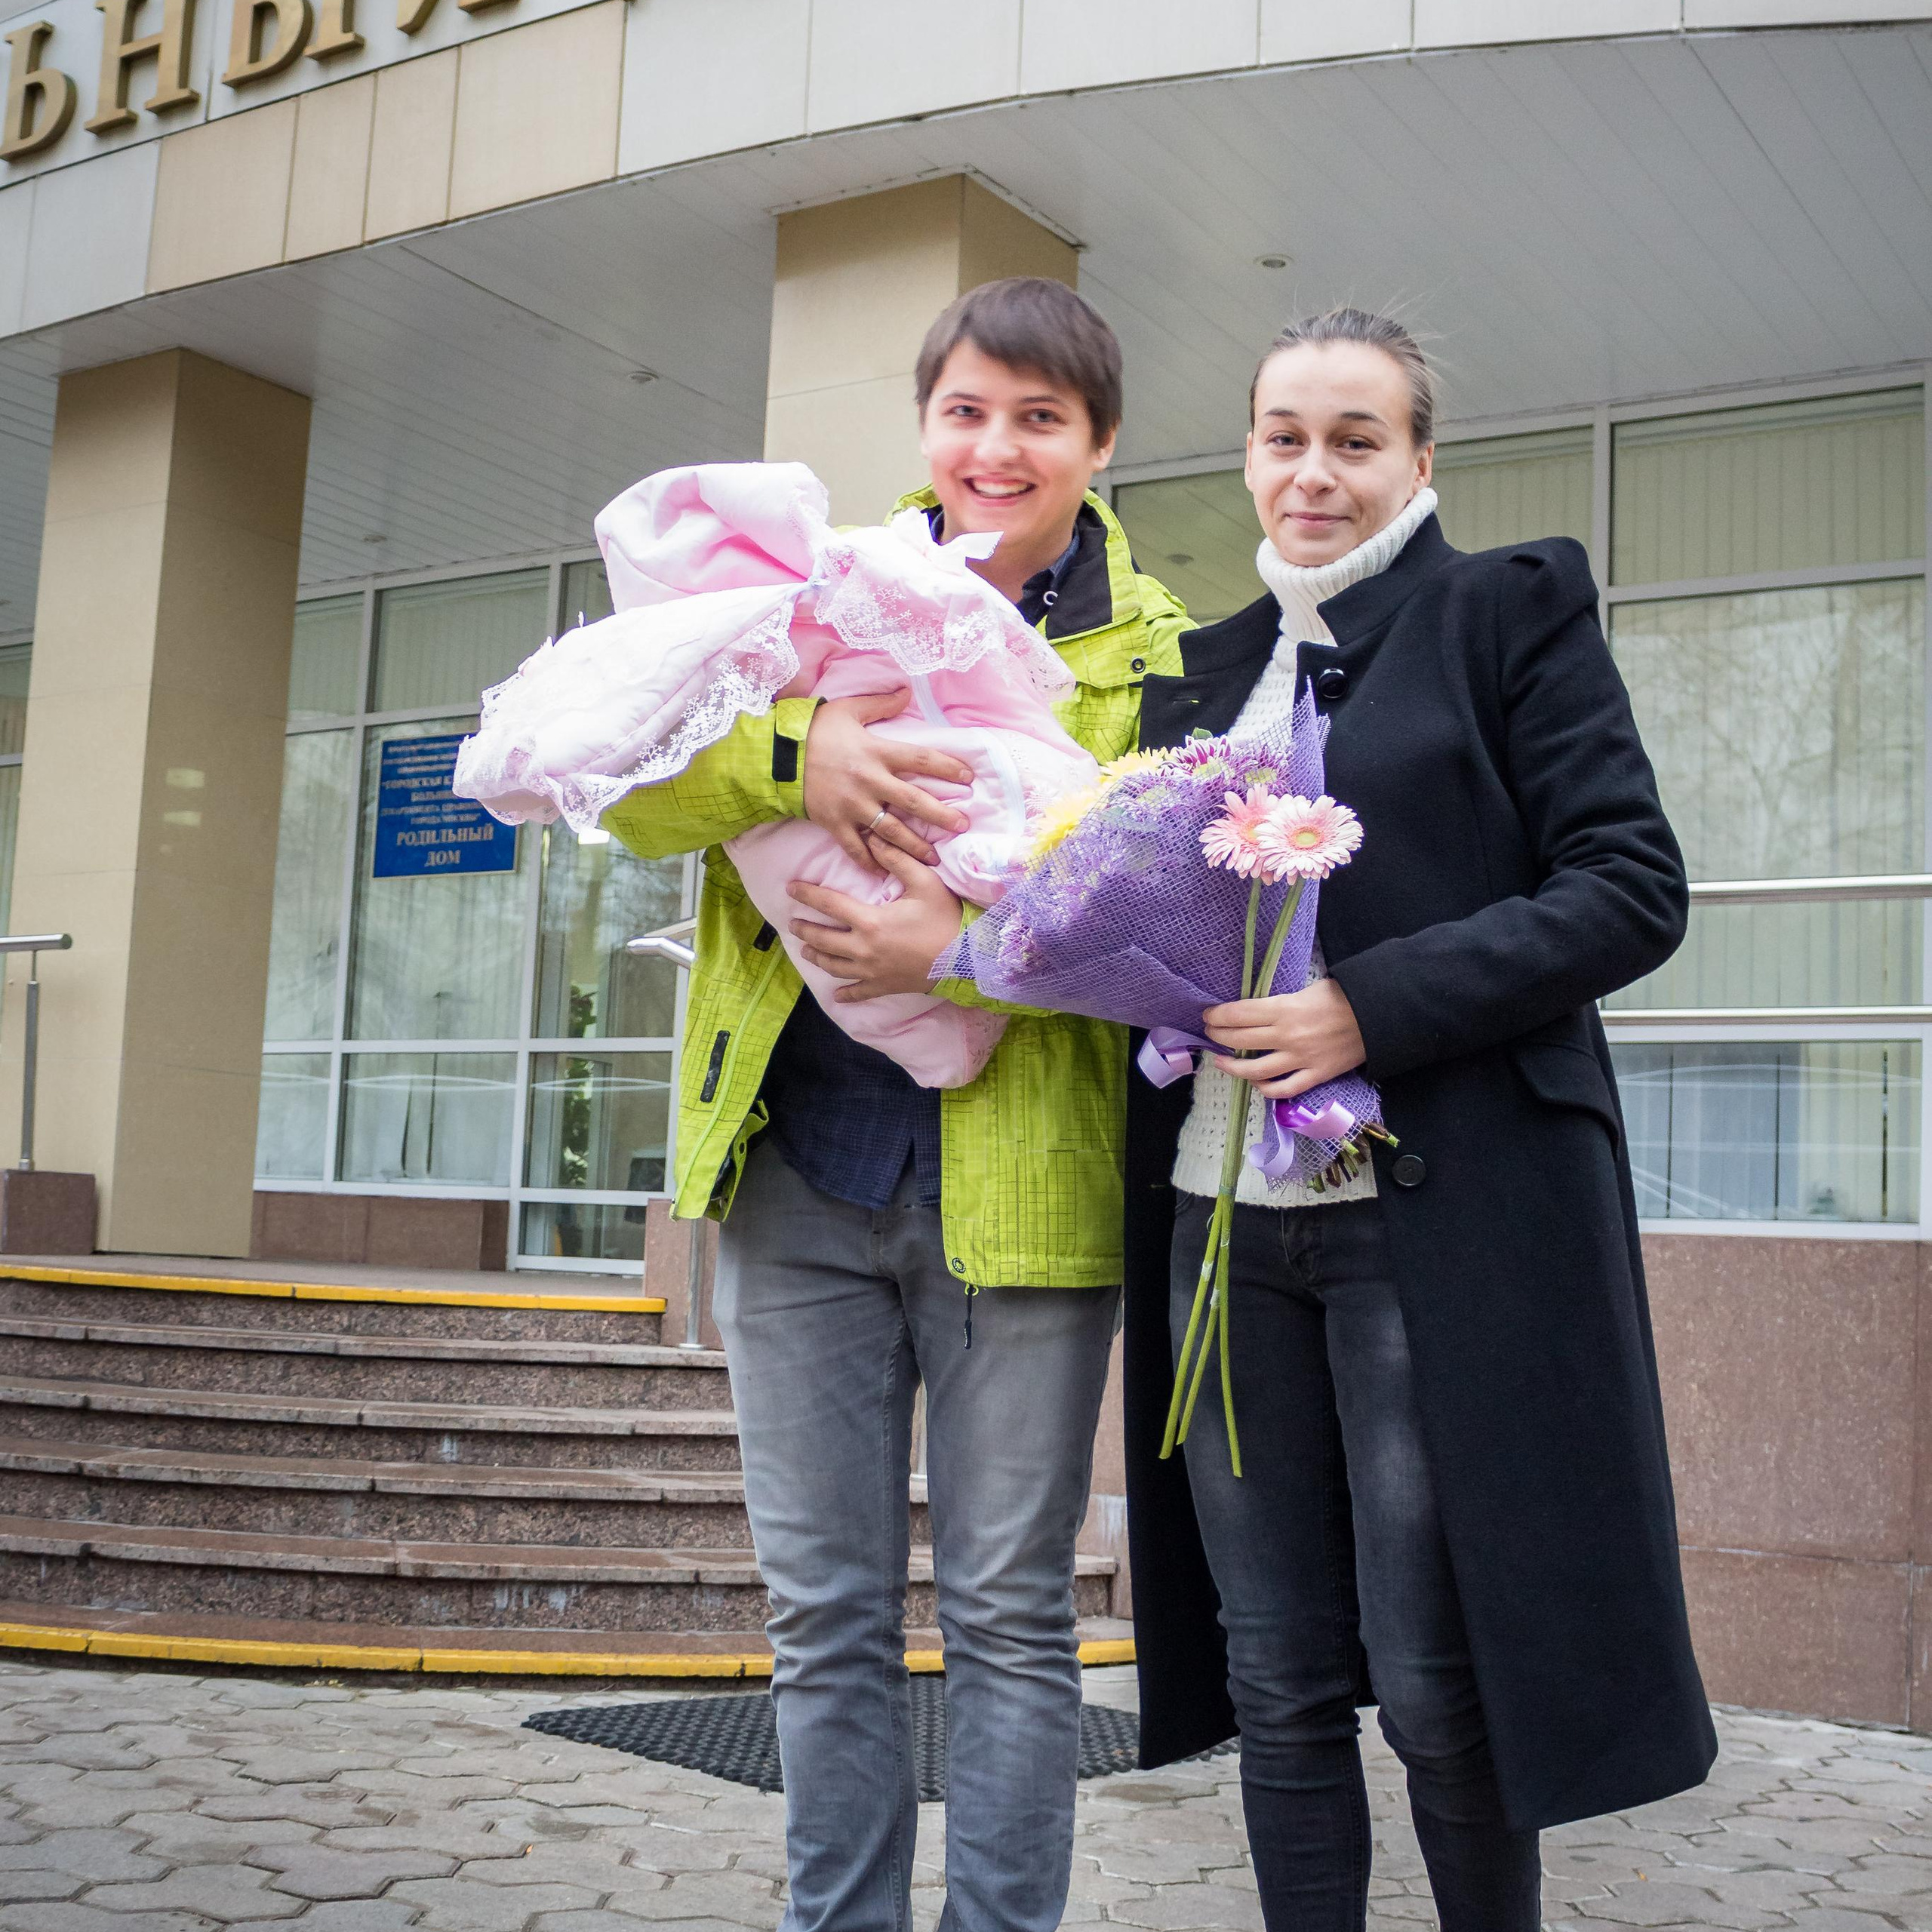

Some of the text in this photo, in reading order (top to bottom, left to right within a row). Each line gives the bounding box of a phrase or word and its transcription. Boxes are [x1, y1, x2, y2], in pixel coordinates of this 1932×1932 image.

[0, 0, 522, 162] ЬНЫ
[396, 823, 494, 846] РОДИЛЬНЫЙ
[424, 850, 461, 866] ДОМ
